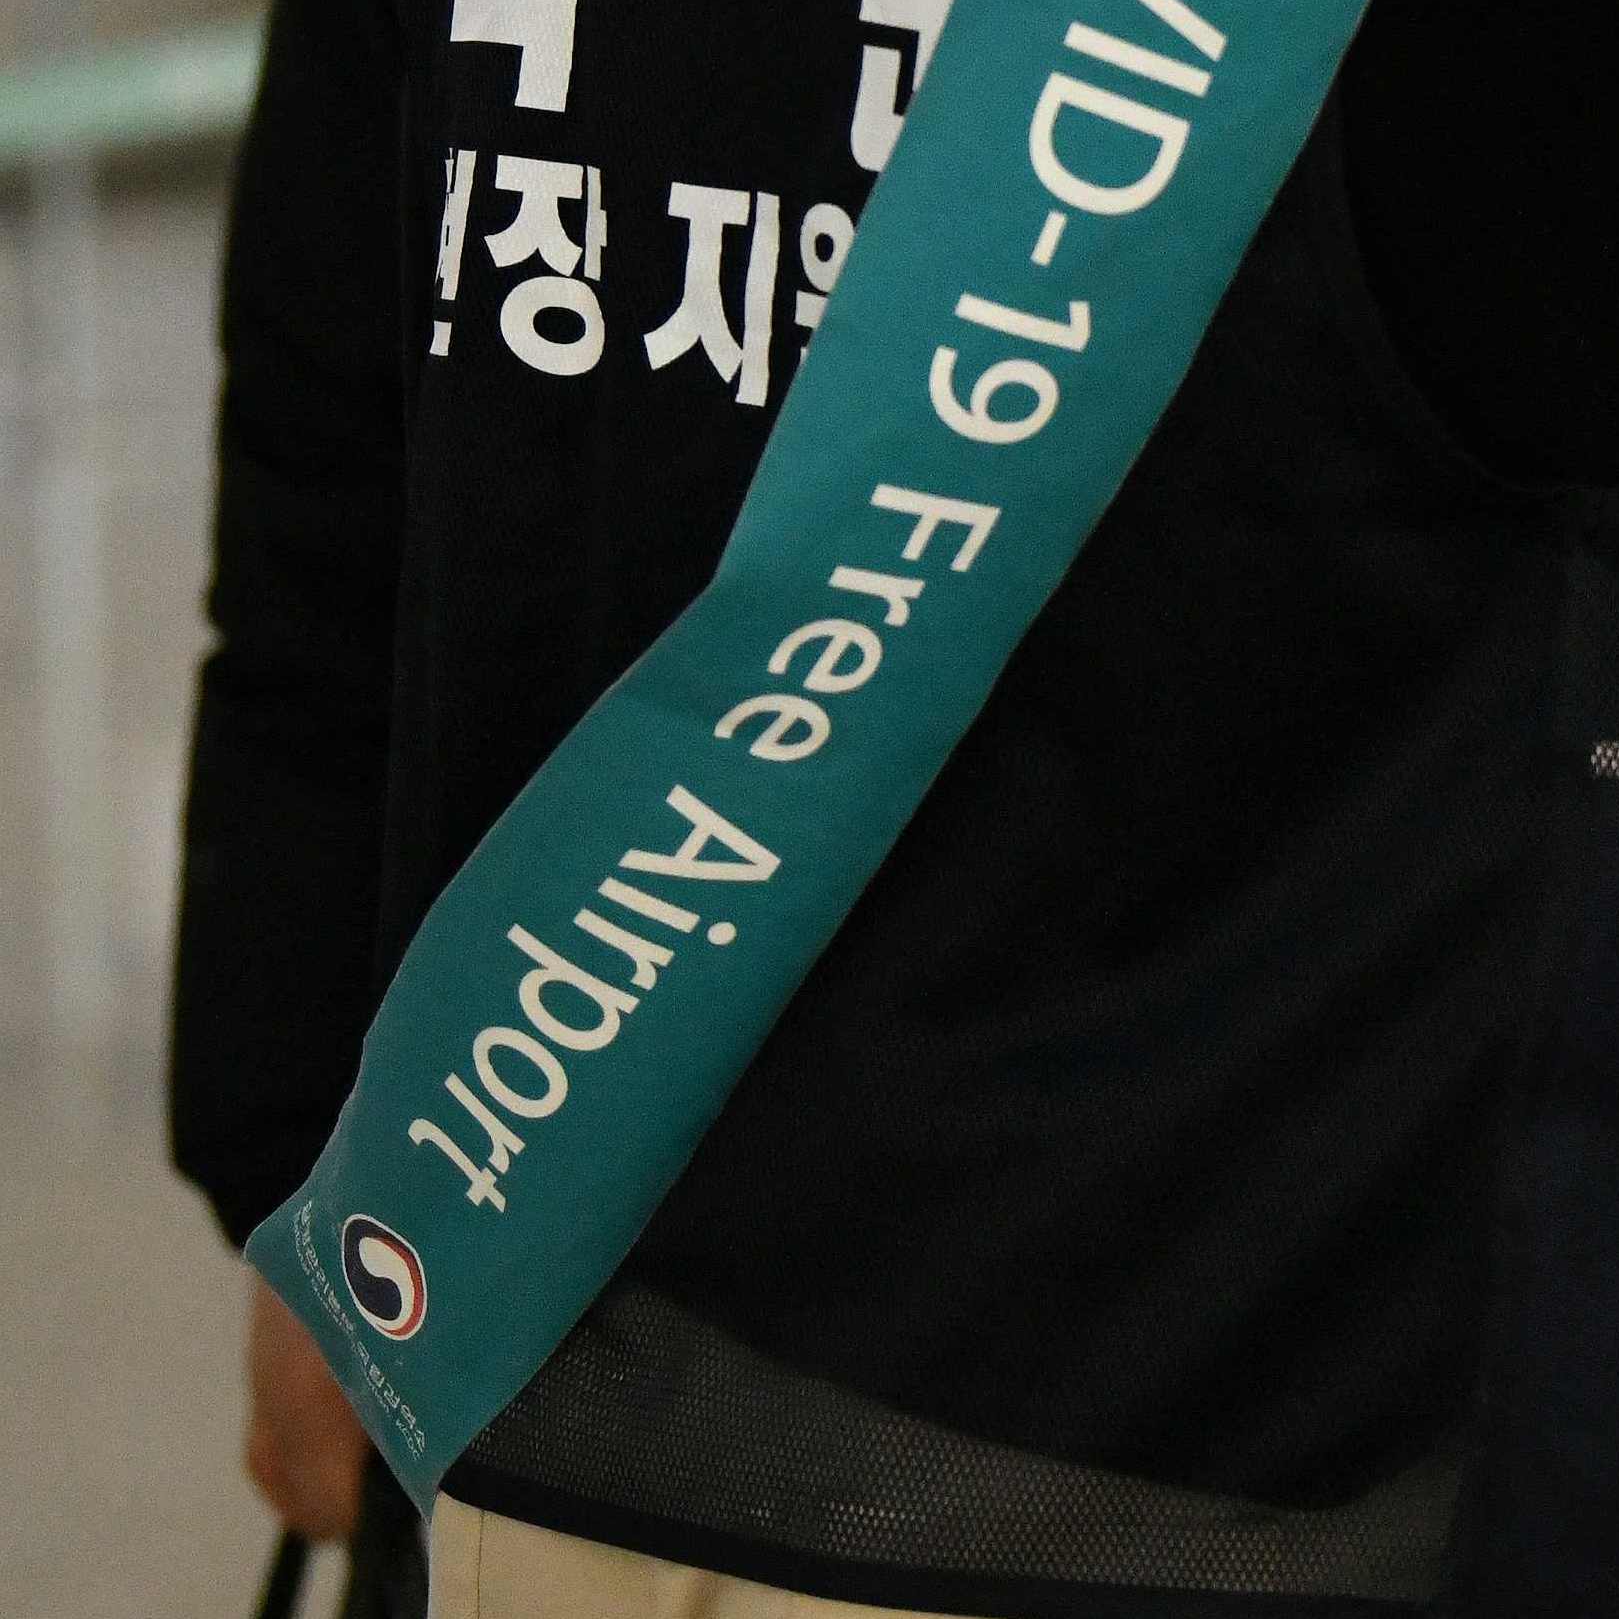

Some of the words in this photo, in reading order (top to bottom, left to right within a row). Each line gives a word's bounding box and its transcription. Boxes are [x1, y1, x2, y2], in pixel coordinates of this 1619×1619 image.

[430, 147, 608, 376] 장
[714, 483, 1001, 762] Free
[407, 783, 782, 1213] Airport
